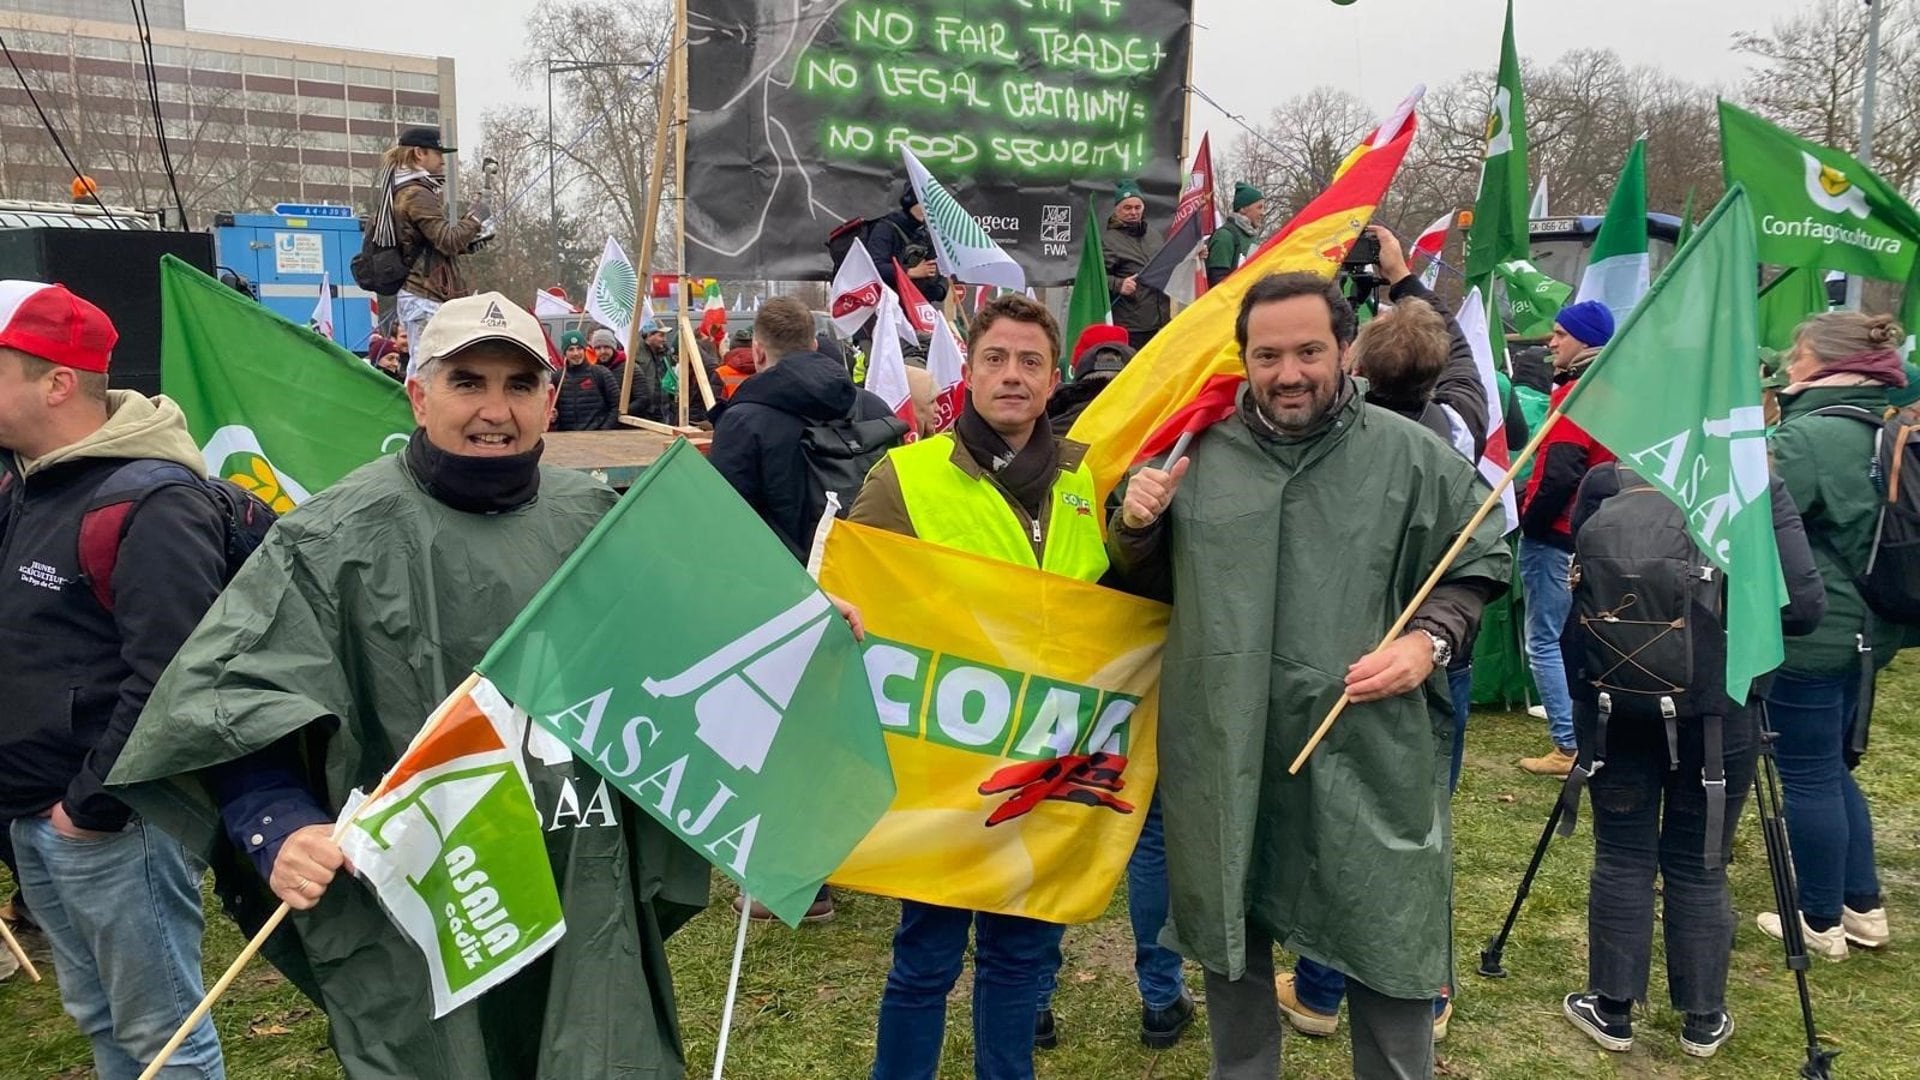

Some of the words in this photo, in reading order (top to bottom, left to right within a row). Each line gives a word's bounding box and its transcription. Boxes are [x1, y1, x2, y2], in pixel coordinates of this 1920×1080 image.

[855, 8, 914, 45] NO
[935, 17, 1019, 61] FAIR
[807, 58, 858, 90] NO
[877, 62, 991, 107] LEGAL
[829, 124, 875, 152] NO
[885, 127, 979, 164] FOOD
[991, 133, 1143, 171] SECURITY!
[972, 215, 1020, 234] ogeca
[1043, 243, 1068, 256] FWA
[1761, 214, 1902, 254] Confagricoltura
[862, 643, 1137, 759] COAG
[544, 686, 763, 880] ASAJA
[443, 844, 520, 958] ASAJA
[445, 902, 484, 971] cádiz
